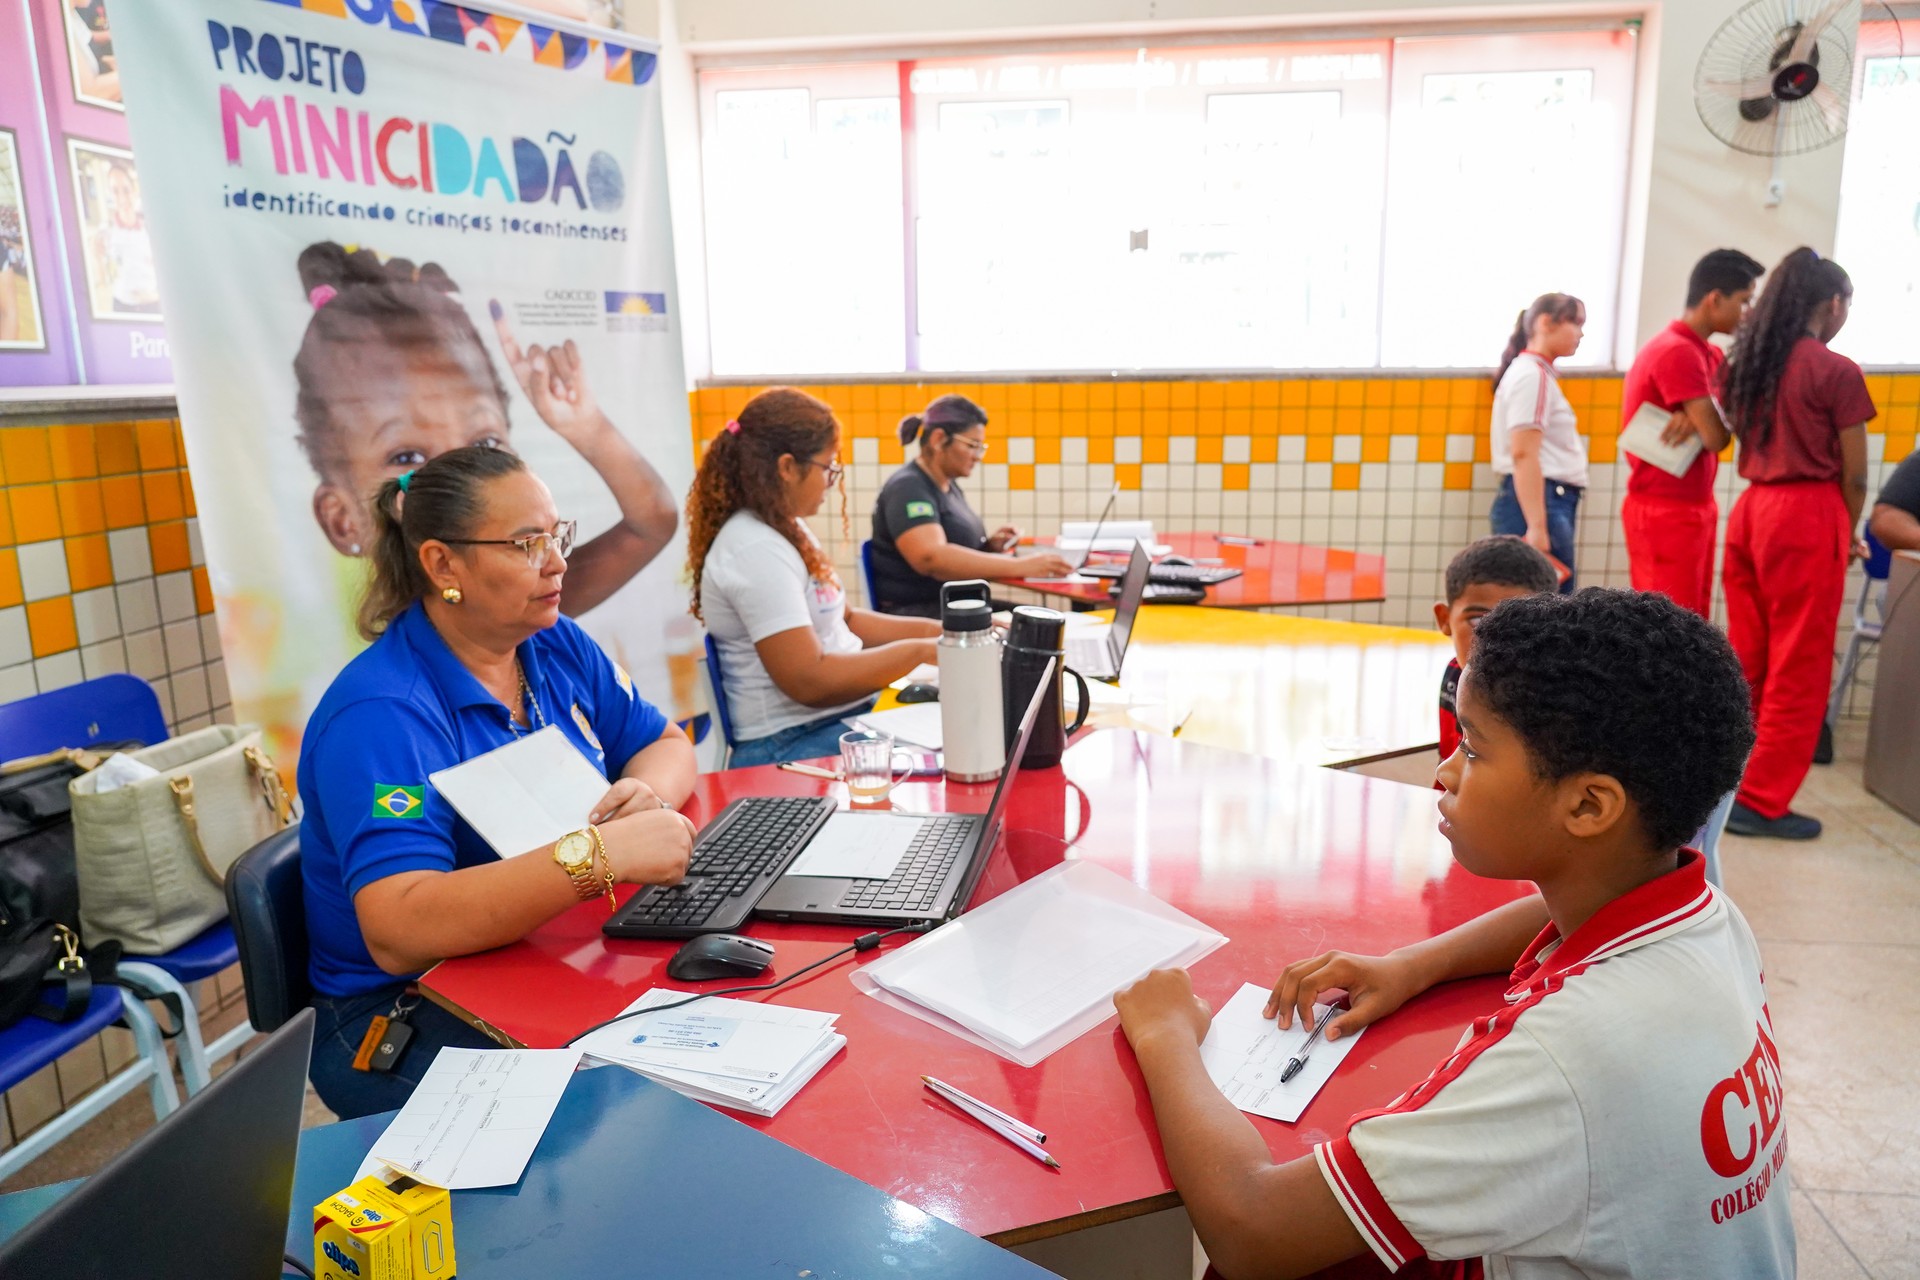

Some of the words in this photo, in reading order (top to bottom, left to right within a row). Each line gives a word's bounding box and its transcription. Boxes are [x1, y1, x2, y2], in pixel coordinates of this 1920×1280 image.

[207, 20, 366, 95] PROJETO
[219, 84, 627, 214] MINICIDADÃO
[223, 185, 395, 222] identificando
[406, 207, 493, 234] crianças
[501, 216, 628, 242] tocantinenses
[329, 1201, 355, 1218] BACCHI
[1711, 1161, 1771, 1225] COLÉGIO
